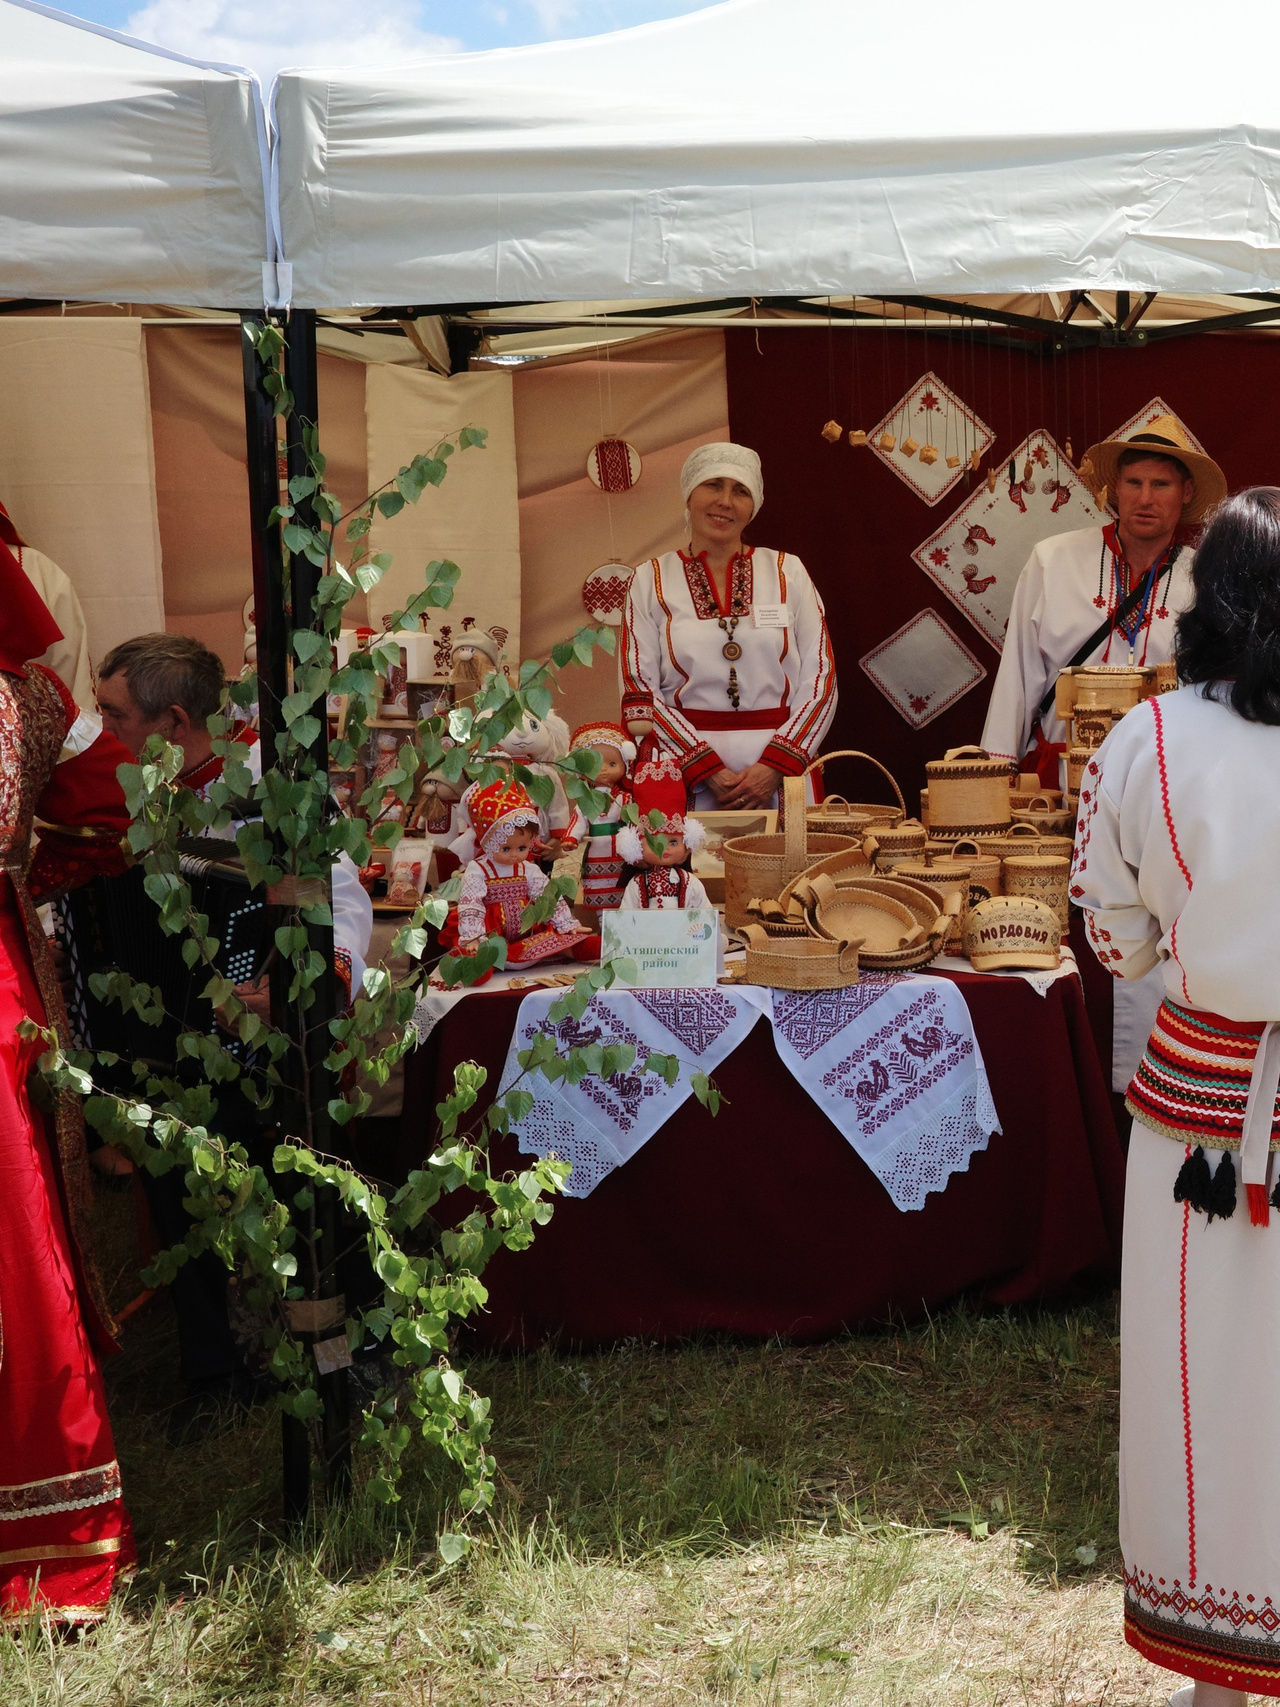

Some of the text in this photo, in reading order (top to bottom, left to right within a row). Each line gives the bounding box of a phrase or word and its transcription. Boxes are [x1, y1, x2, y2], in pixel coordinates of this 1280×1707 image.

[1079, 728, 1105, 739] Сахар
[980, 924, 1049, 944] МОРДОВИЯ
[623, 944, 699, 955] Атяшевский
[642, 958, 678, 970] район
